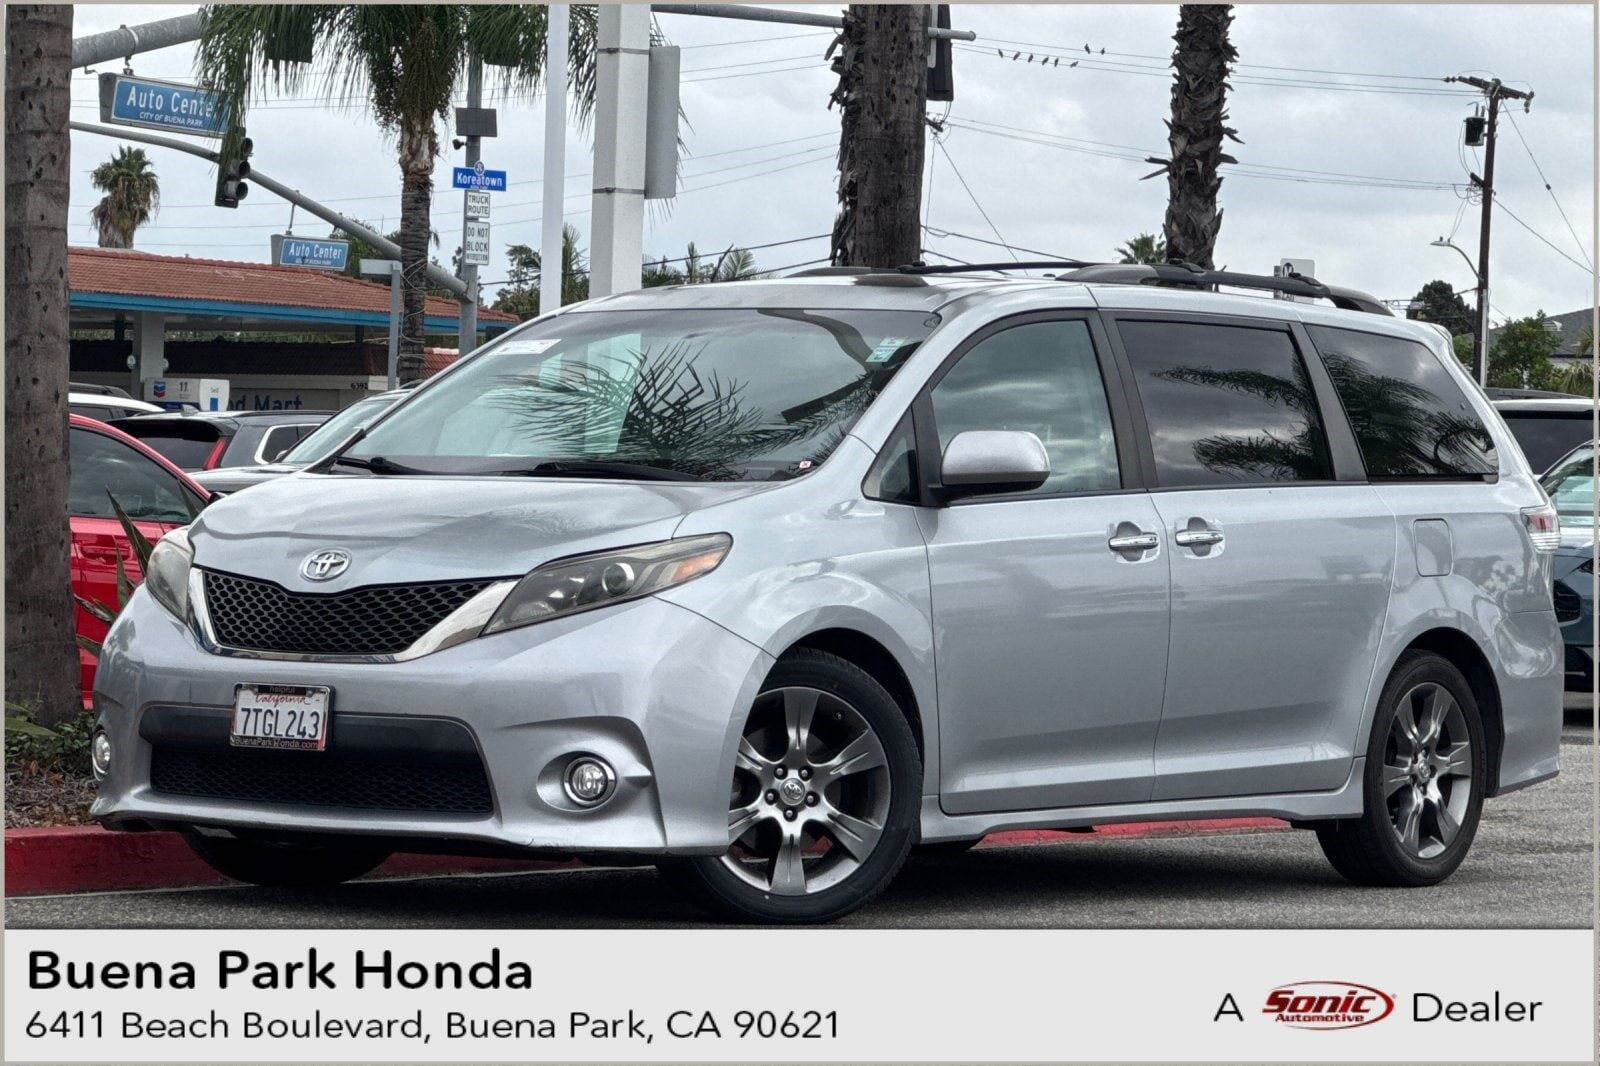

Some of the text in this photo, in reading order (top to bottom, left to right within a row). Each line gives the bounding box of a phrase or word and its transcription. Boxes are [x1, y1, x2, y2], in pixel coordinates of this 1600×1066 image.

[126, 86, 217, 119] Auto Cente
[139, 111, 203, 127] CITY OF BUENA PARK
[456, 172, 503, 187] Koreatown
[468, 194, 489, 205] TRUCK
[467, 205, 489, 215] ROUTE
[467, 226, 488, 238] DO NOT
[288, 242, 342, 259] Auto Center
[466, 240, 488, 252] BLOCK
[179, 382, 188, 392] 11
[254, 395, 302, 411] Mart
[241, 707, 320, 739] 7TGL243
